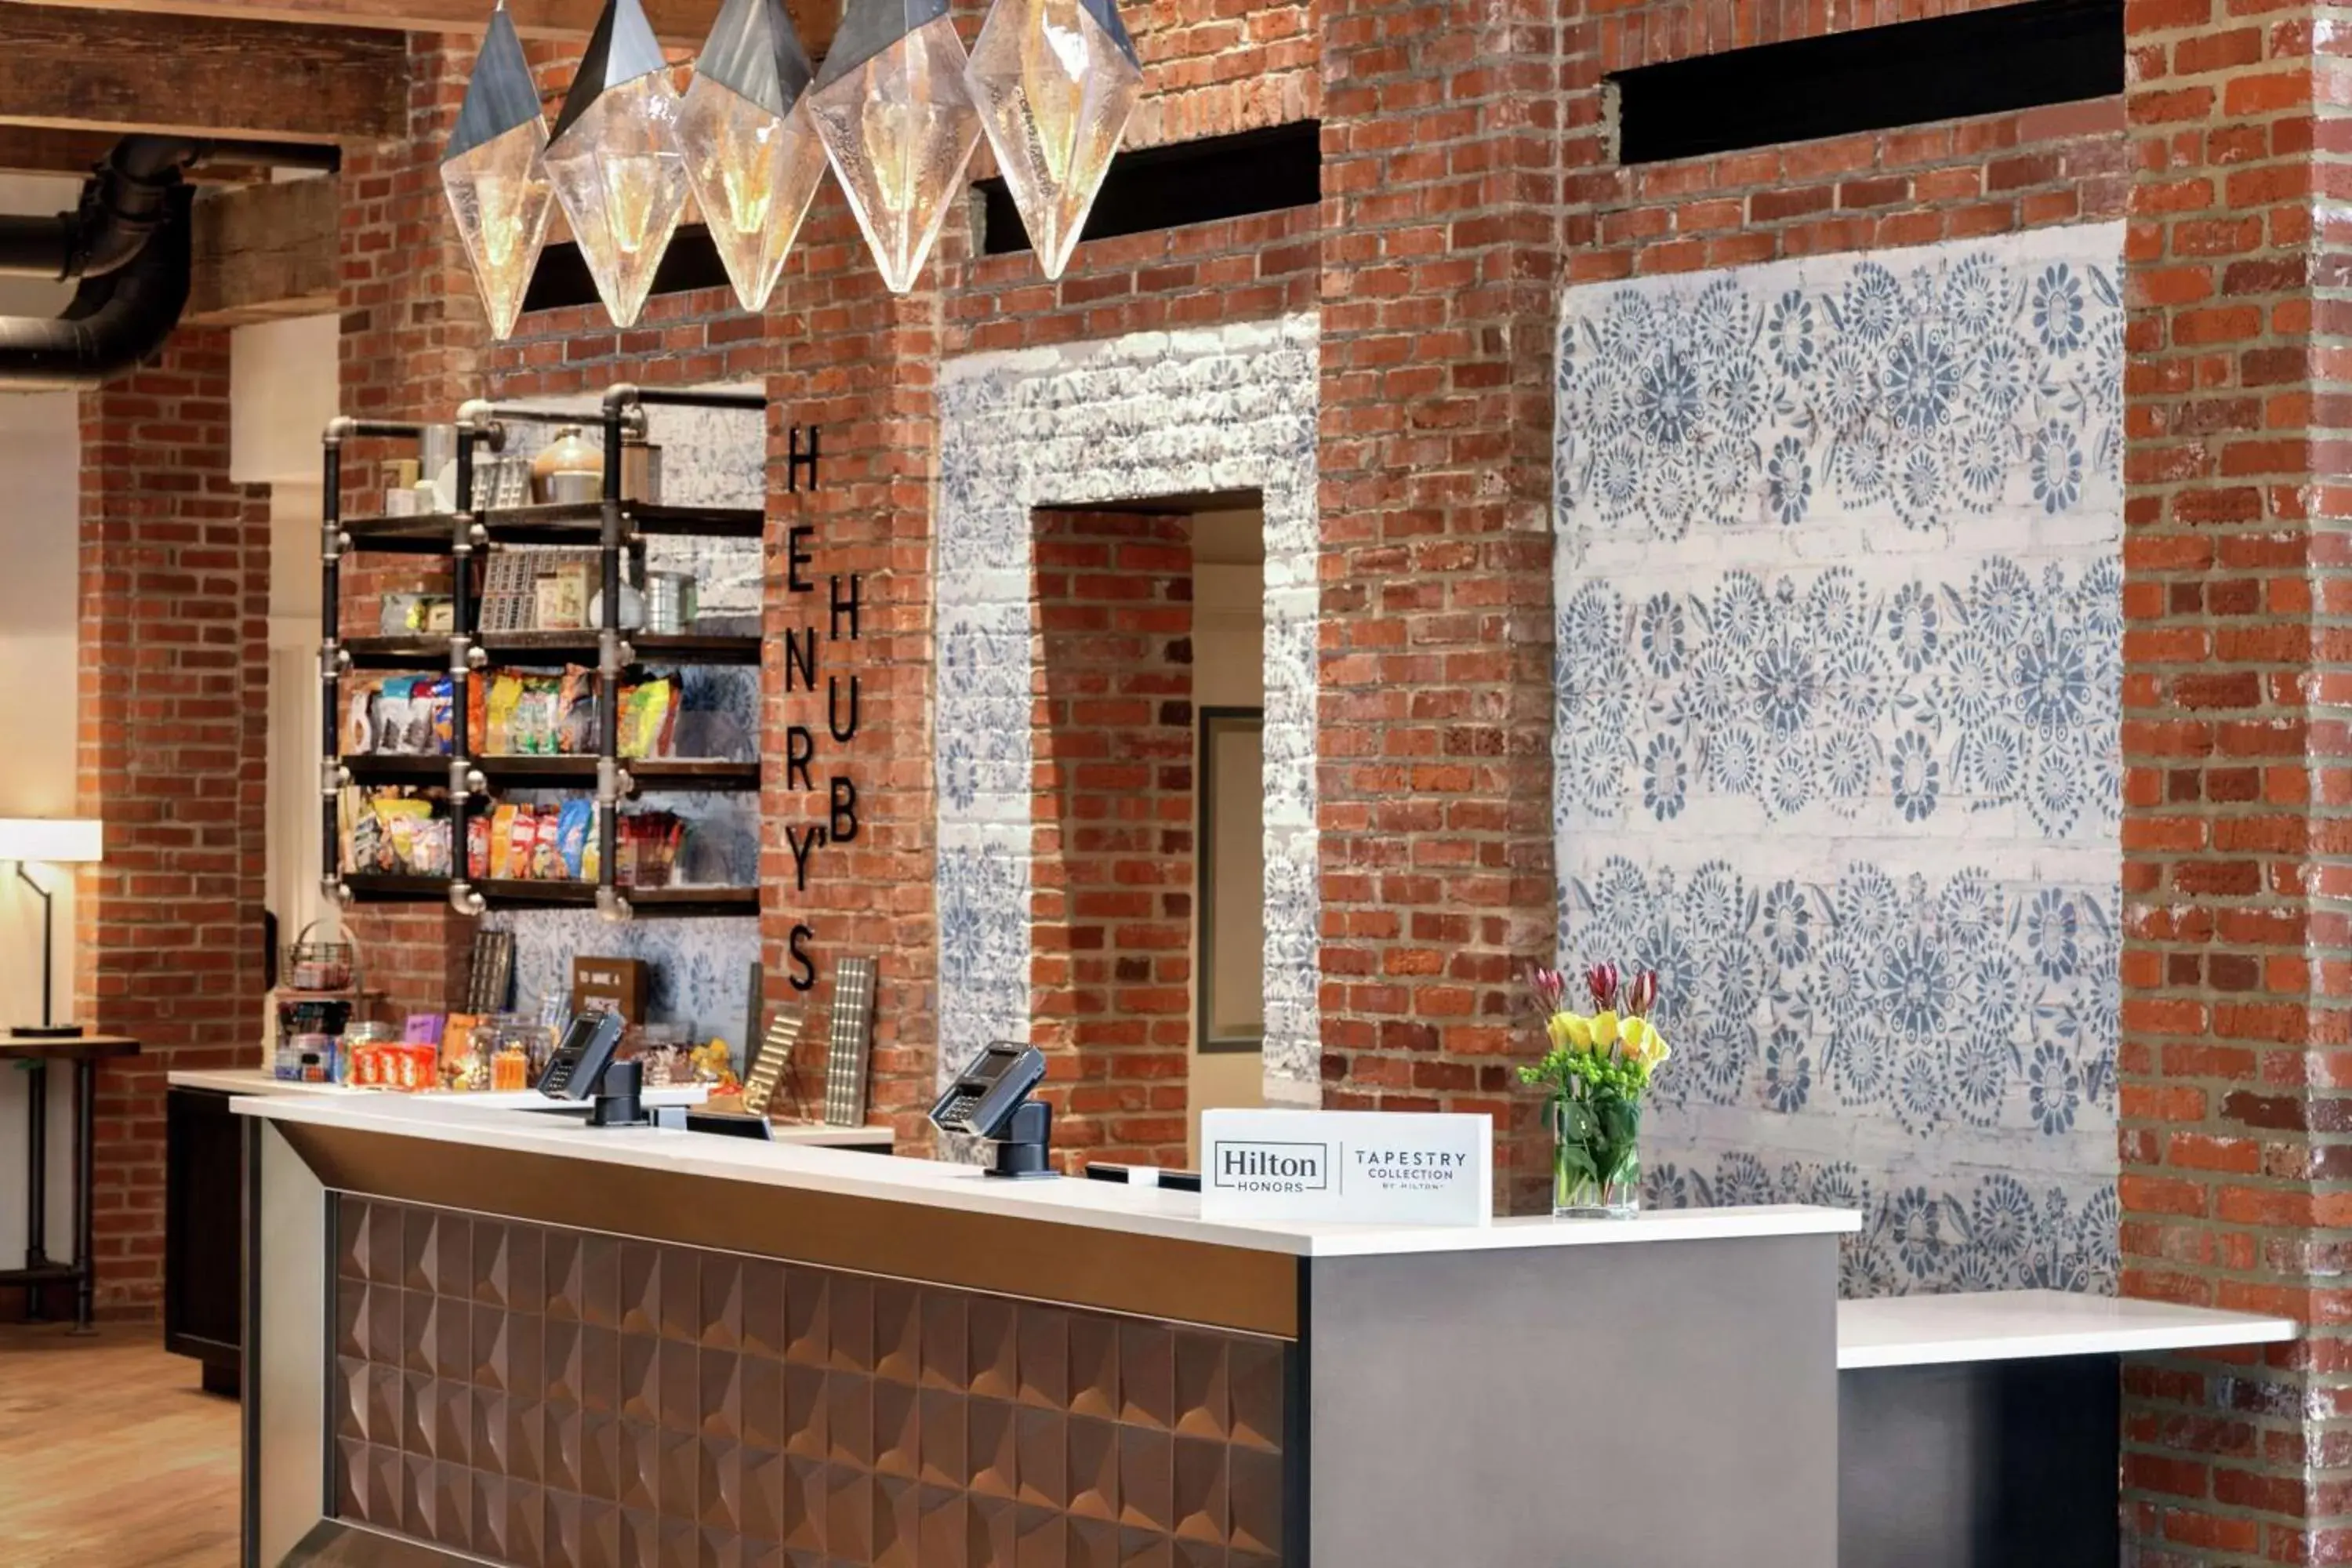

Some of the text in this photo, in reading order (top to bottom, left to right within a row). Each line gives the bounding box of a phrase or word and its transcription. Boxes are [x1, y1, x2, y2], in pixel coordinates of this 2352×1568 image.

[785, 426, 827, 991] HENRY'S
[828, 575, 859, 843] HUB
[1224, 1150, 1317, 1178] Hilton
[1354, 1149, 1467, 1167] TAPESTRY
[1367, 1167, 1454, 1180] COLLECTION
[1238, 1181, 1304, 1192] HONORS
